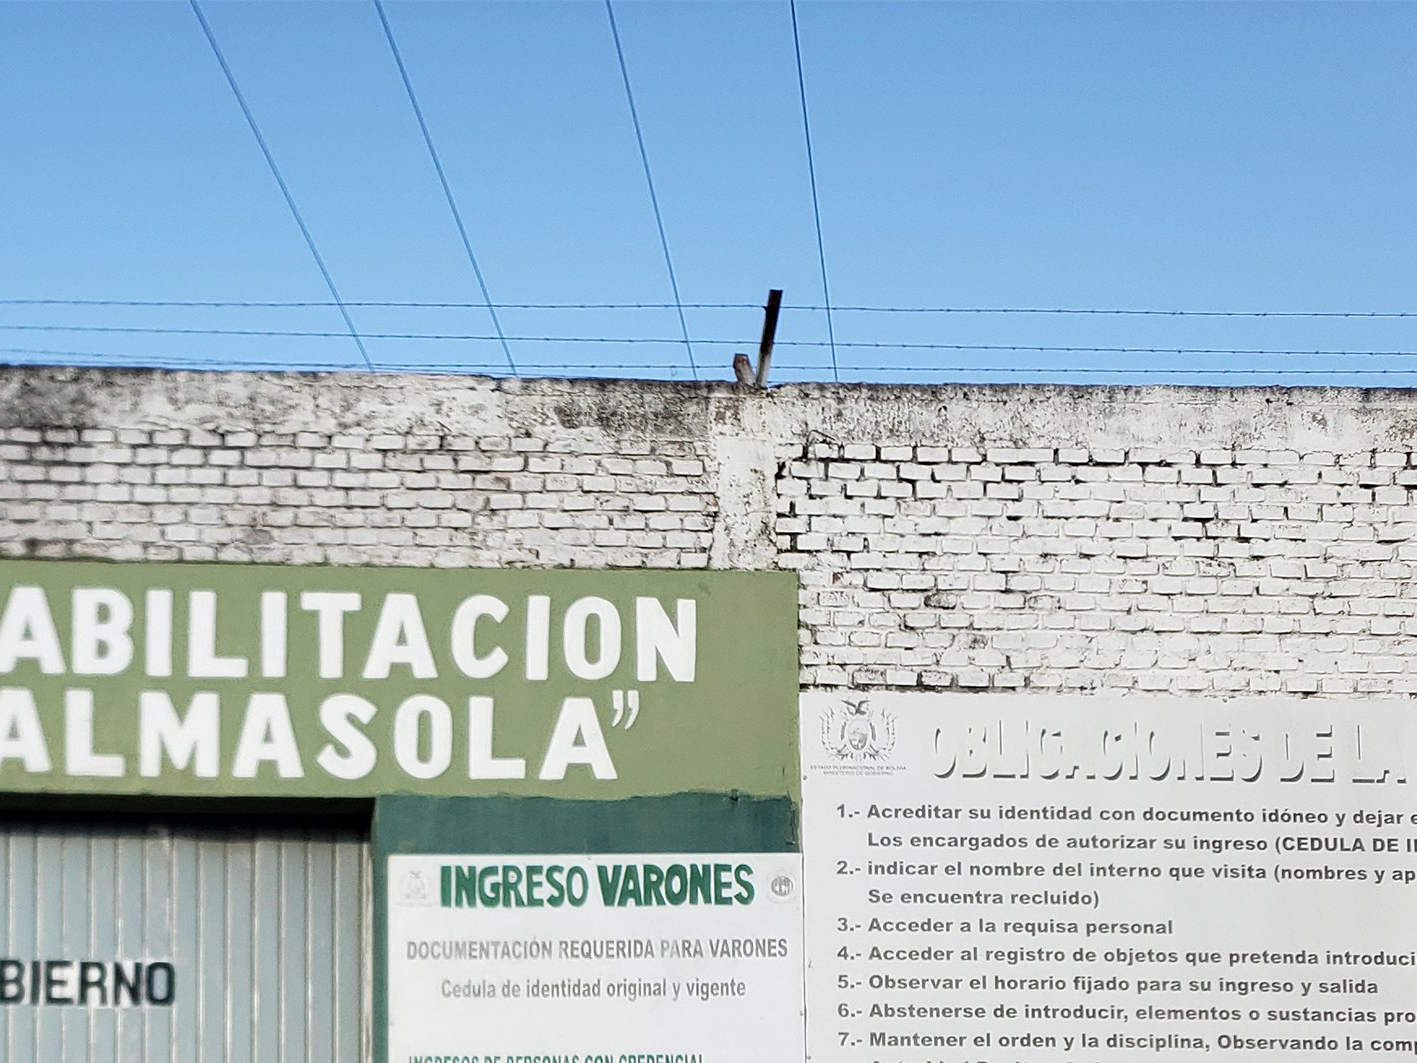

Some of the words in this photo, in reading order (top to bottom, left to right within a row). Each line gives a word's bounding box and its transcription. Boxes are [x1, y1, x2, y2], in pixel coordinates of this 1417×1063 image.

[933, 719, 1264, 784] OBLIGACIONES
[1279, 723, 1336, 784] DE
[1351, 723, 1408, 784] LA
[836, 803, 861, 819] 1.-
[866, 803, 963, 820] Acreditar
[968, 808, 992, 820] su
[998, 804, 1093, 821] identidad
[1099, 809, 1136, 822] con
[1142, 806, 1256, 823] documento
[1261, 807, 1329, 824] idóneo
[1334, 812, 1347, 828] y
[1352, 809, 1405, 829] dejar
[867, 831, 904, 848] Los
[909, 833, 1029, 852] encargados
[1034, 833, 1060, 849] de
[1065, 834, 1158, 850] autorizar
[1162, 838, 1186, 850] su
[1192, 834, 1268, 854] ingreso
[1274, 835, 1367, 856] (CEDULA
[1372, 837, 1400, 853] DE
[836, 860, 862, 875] 2.-
[867, 860, 939, 876] indicar
[944, 860, 963, 876] el
[969, 861, 1046, 877] nombre
[1052, 861, 1083, 877] del
[1089, 862, 1163, 878] interno
[1168, 866, 1206, 882] que
[1211, 863, 1267, 880] visita
[1273, 864, 1368, 884] (nombres
[1373, 869, 1386, 885] y
[439, 864, 589, 909] INGRESO
[595, 863, 756, 908] VARONES
[867, 888, 894, 904] Se
[899, 889, 1004, 905] encuentra
[1010, 890, 1100, 910] recluido)
[836, 916, 862, 932] 3.-
[867, 917, 954, 933] Acceder
[978, 917, 997, 933] la
[1003, 918, 1079, 937] requisa
[1085, 919, 1173, 938] personal
[406, 936, 553, 960] DOCUMENTACIÓN
[558, 938, 656, 961] REQUERIDA
[660, 938, 704, 959] PARA
[708, 937, 788, 959] VARONES
[836, 945, 863, 961] 4.-
[867, 945, 955, 961] Acceder
[960, 946, 978, 962] al
[985, 946, 1066, 966] registro
[1072, 947, 1098, 963] de
[1103, 947, 1179, 967] objetos
[1185, 951, 1223, 967] que
[1228, 949, 1319, 968] pretenda
[441, 978, 496, 999] Cedula
[501, 978, 521, 998] de
[526, 977, 601, 999] identidad
[606, 977, 667, 1003] original
[671, 981, 682, 1002] y
[685, 977, 746, 1002] vigente
[837, 974, 863, 990] 5.-
[868, 974, 964, 990] Observar
[968, 974, 987, 990] el
[994, 974, 1067, 991] horario
[1072, 975, 1131, 995] fijado
[1136, 979, 1182, 995] para
[1188, 980, 1213, 992] su
[1218, 976, 1295, 997] ingreso
[1300, 981, 1313, 997] y
[1318, 978, 1379, 995] salida
[837, 1002, 863, 1018] 6.-
[868, 1002, 987, 1019] Abstenerse
[992, 1003, 1018, 1019] de
[1024, 1003, 1129, 1024] introducir,
[1135, 1004, 1242, 1021] elementos
[1266, 1006, 1377, 1023] sustancias
[837, 1031, 863, 1047] 7.-
[869, 1031, 968, 1048] Mantener
[972, 1032, 991, 1048] el
[997, 1032, 1057, 1048] orden
[1062, 1036, 1076, 1052] y
[1081, 1032, 1100, 1049] la
[1105, 1033, 1211, 1053] disciplina,
[1216, 1034, 1339, 1051] Observando
[1345, 1035, 1364, 1052] la
